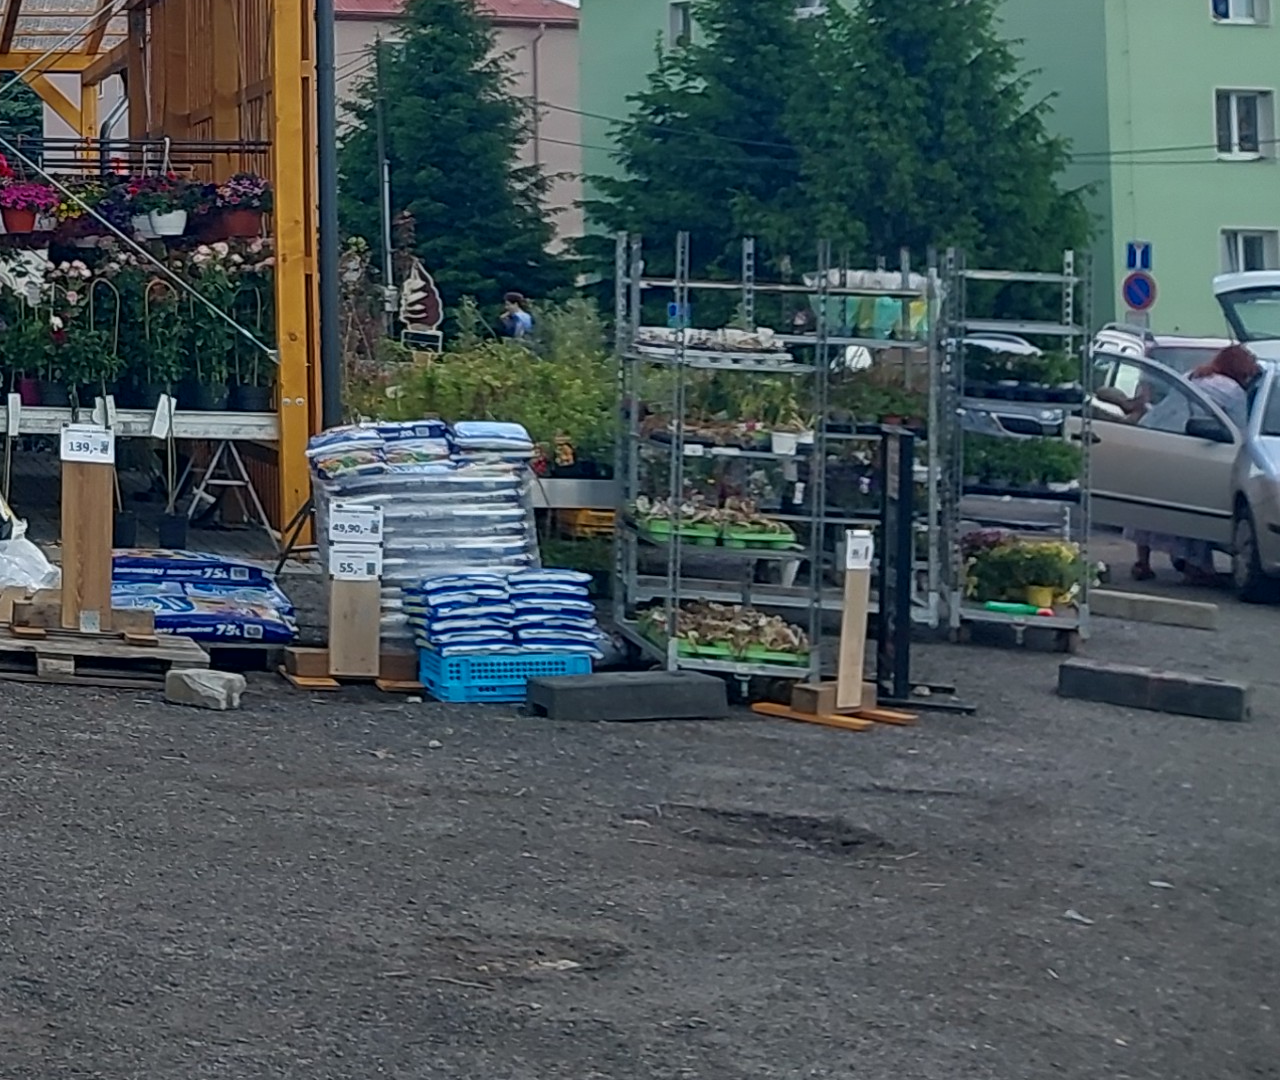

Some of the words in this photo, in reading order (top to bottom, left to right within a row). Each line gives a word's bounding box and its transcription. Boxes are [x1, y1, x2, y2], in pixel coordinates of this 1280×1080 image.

[68, 441, 99, 455] 139,-
[332, 523, 369, 535] 49,90,-
[339, 562, 364, 575] 55,-
